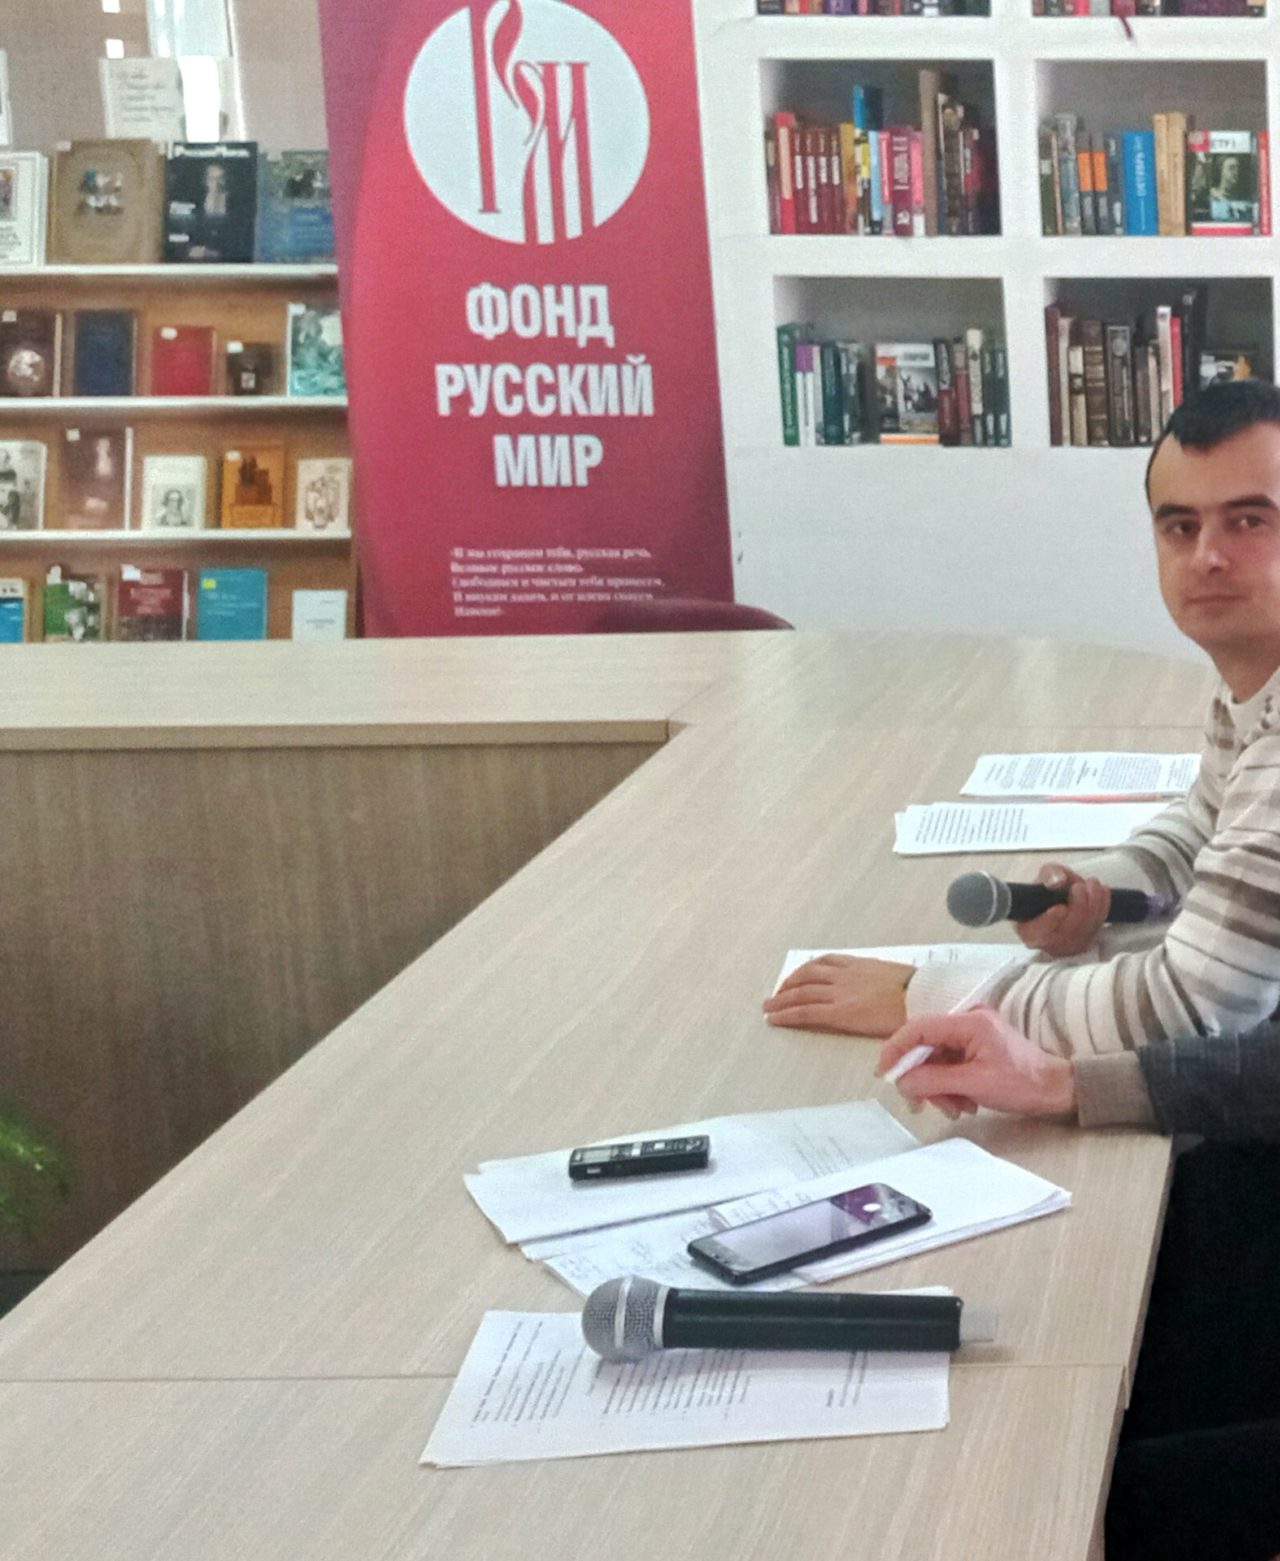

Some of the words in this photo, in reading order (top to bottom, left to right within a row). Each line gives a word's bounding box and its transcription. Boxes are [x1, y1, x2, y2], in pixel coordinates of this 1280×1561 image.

[466, 282, 615, 348] ФОНД
[434, 354, 654, 417] РУССКИЙ
[493, 434, 603, 487] МИР
